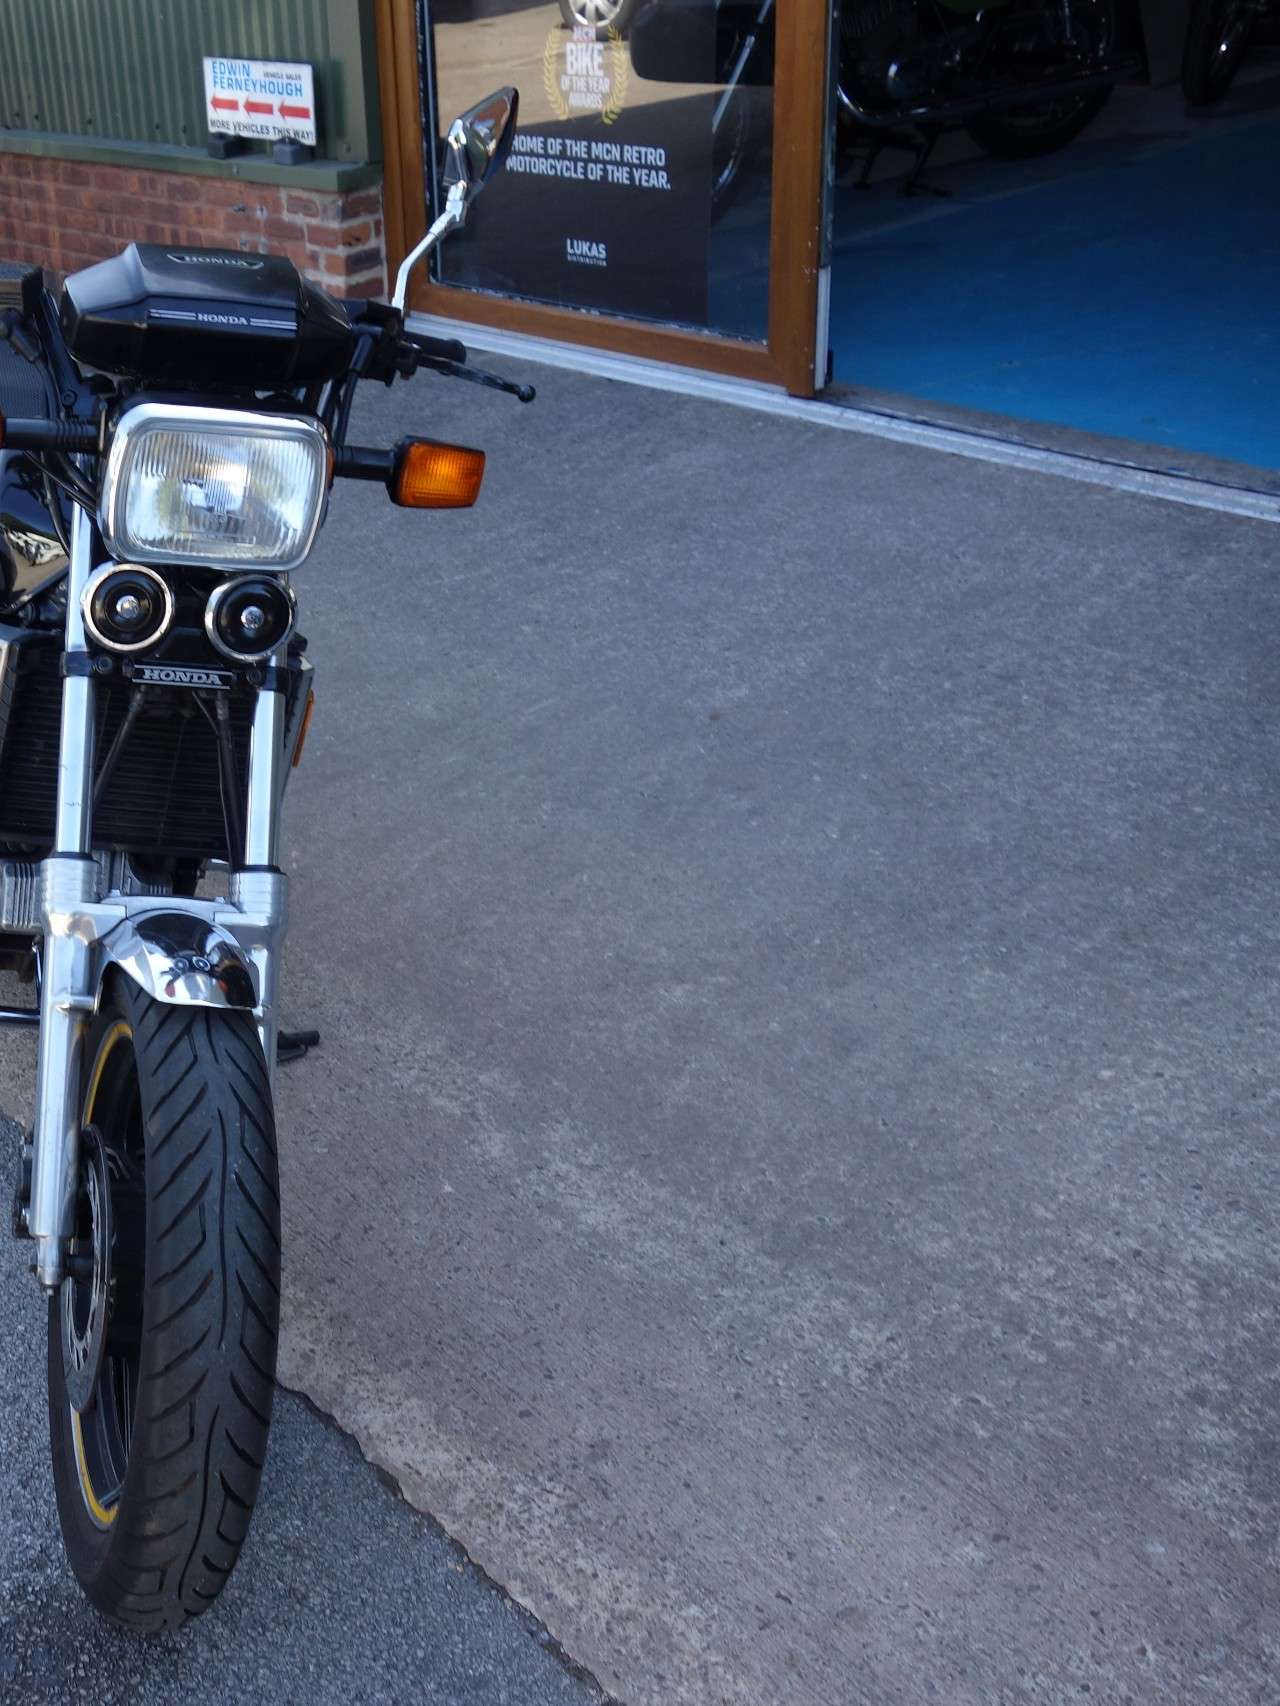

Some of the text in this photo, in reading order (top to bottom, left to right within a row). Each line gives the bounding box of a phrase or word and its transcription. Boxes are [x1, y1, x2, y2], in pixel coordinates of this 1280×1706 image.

[566, 42, 604, 76] BIKE
[212, 61, 250, 76] EDWIN
[213, 76, 303, 96] FERNEYHOUGH
[587, 77, 610, 94] YEAR
[210, 119, 231, 131] MORE
[233, 121, 270, 135] VEHICLES
[272, 126, 291, 137] THIS
[512, 134, 665, 167] HOME OF THE MCN RETRO
[506, 154, 671, 190] MOTORCYCLE OF THE YEAR.
[567, 238, 607, 259] LUKAS
[184, 256, 248, 265] HONDA
[197, 313, 248, 325] HONDA
[143, 668, 222, 685] HONDA
